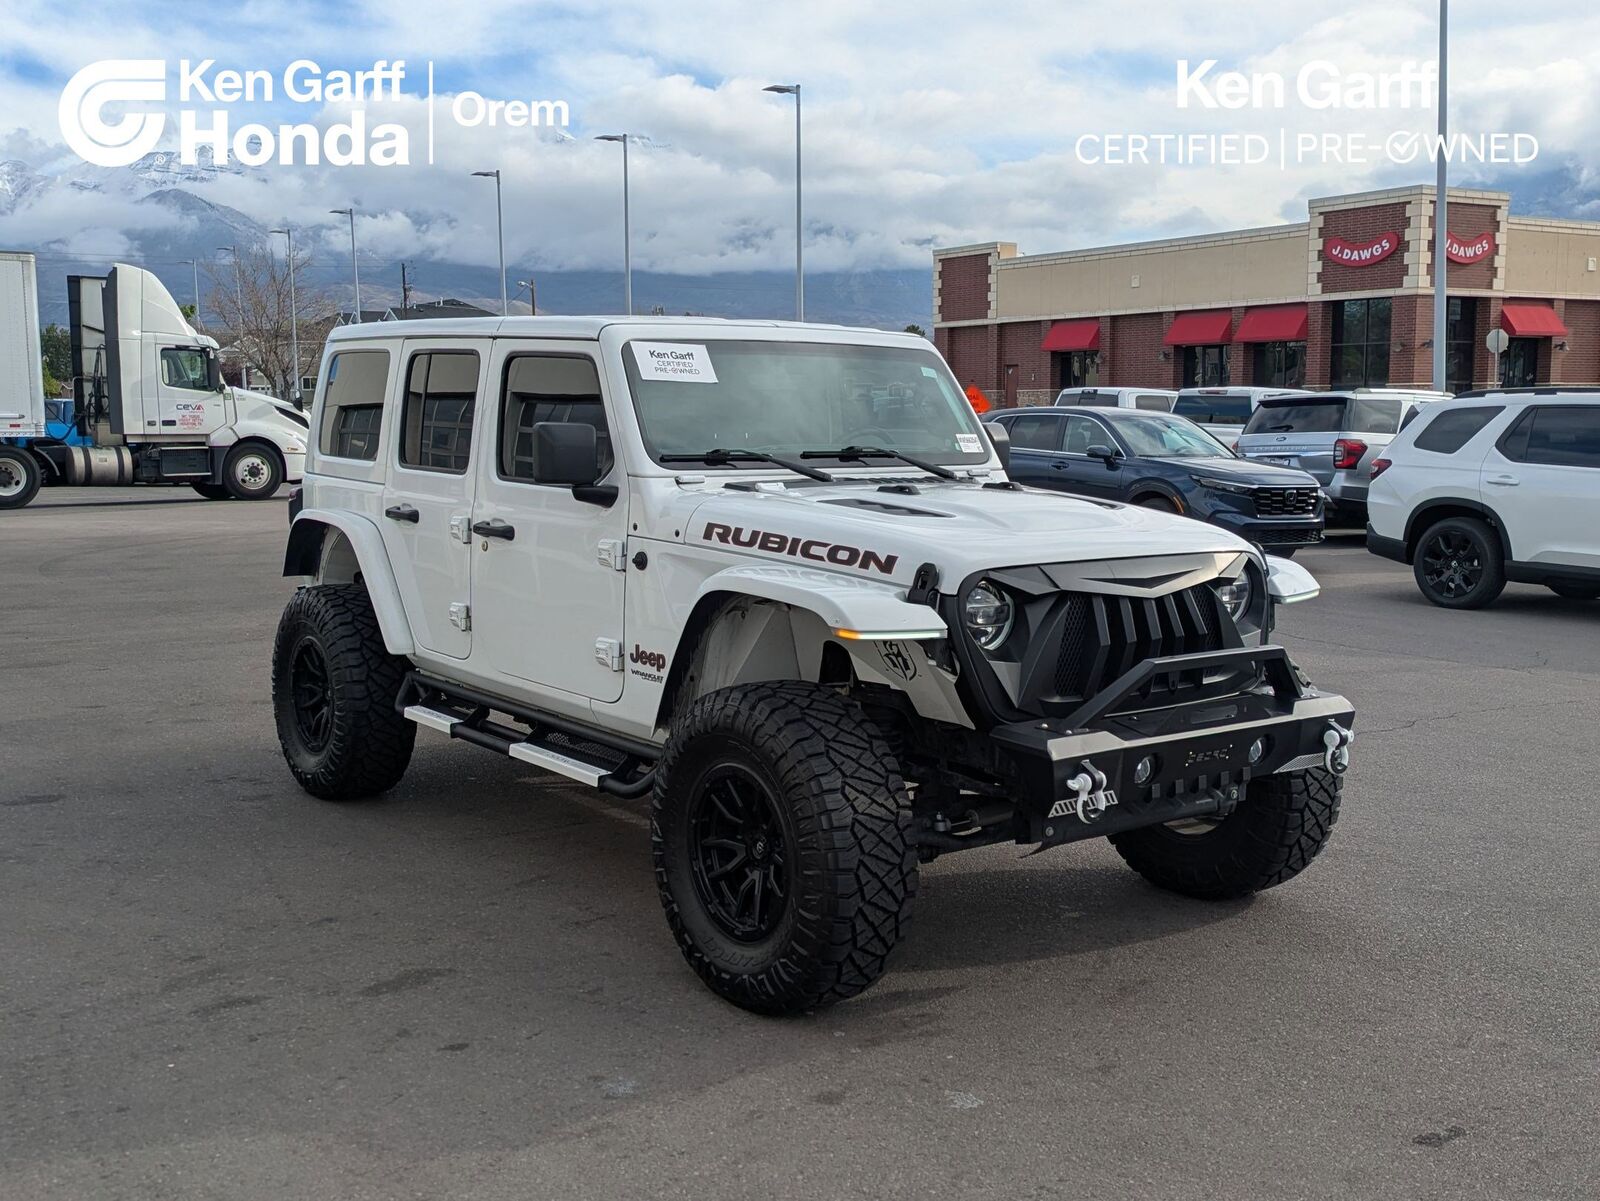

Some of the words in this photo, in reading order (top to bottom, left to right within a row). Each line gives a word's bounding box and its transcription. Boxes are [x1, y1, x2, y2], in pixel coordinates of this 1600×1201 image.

[1331, 239, 1390, 261] J.DAWGS
[648, 350, 669, 360] Ken
[670, 351, 694, 361] Garff
[657, 360, 694, 369] CERTIFIED
[702, 522, 899, 575] RUBICON
[630, 643, 666, 672] Jeep
